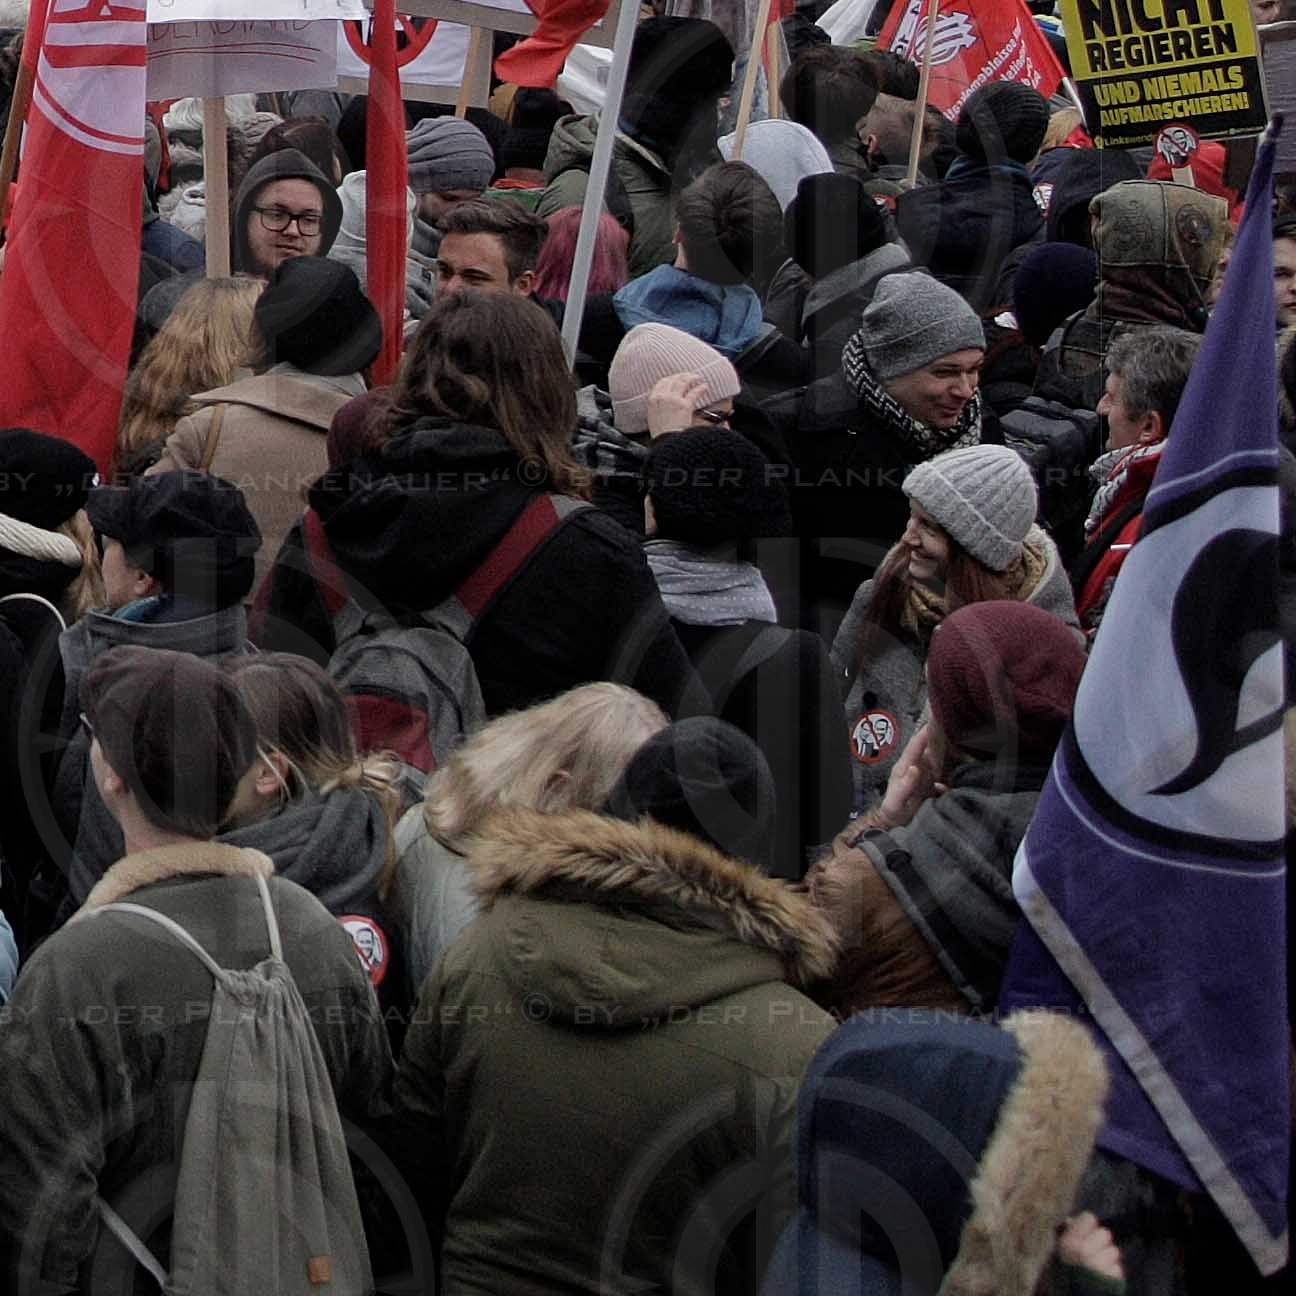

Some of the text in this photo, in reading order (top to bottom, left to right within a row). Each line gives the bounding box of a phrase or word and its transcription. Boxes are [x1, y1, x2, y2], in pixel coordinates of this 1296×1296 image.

[1084, 22, 1237, 73] REGIEREN
[1093, 65, 1244, 107] UND NIEMALS
[1100, 91, 1250, 128] AUFMARSCHIEREN!
[1105, 132, 1153, 147] Linkswend
